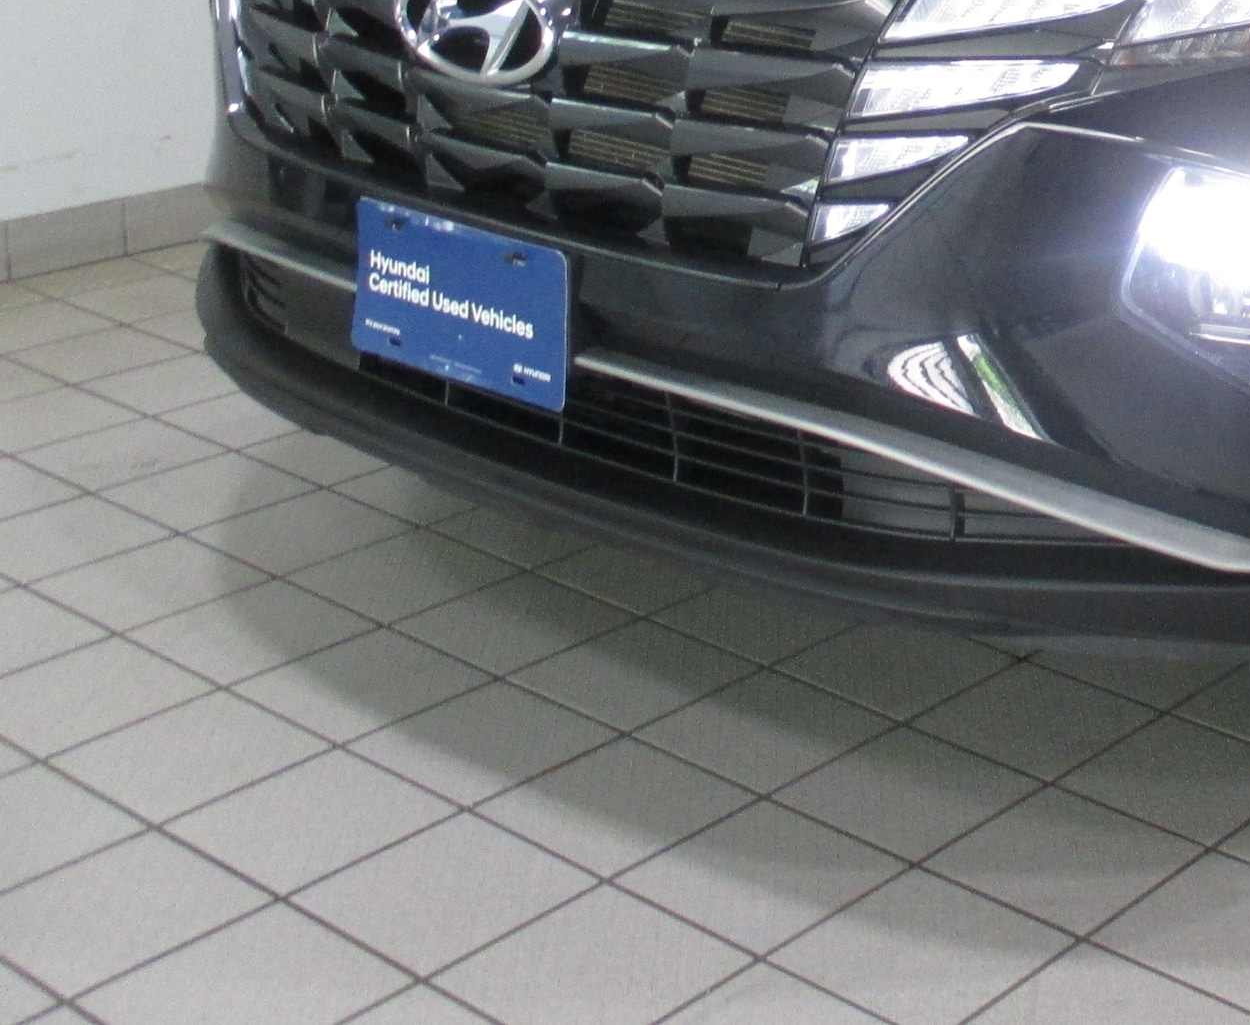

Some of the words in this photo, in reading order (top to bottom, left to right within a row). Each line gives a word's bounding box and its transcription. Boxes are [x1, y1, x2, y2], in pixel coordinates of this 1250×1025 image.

[369, 249, 430, 285] Hyundai
[369, 272, 430, 307] Certified
[432, 290, 469, 320] Used
[471, 302, 534, 340] Vehicles
